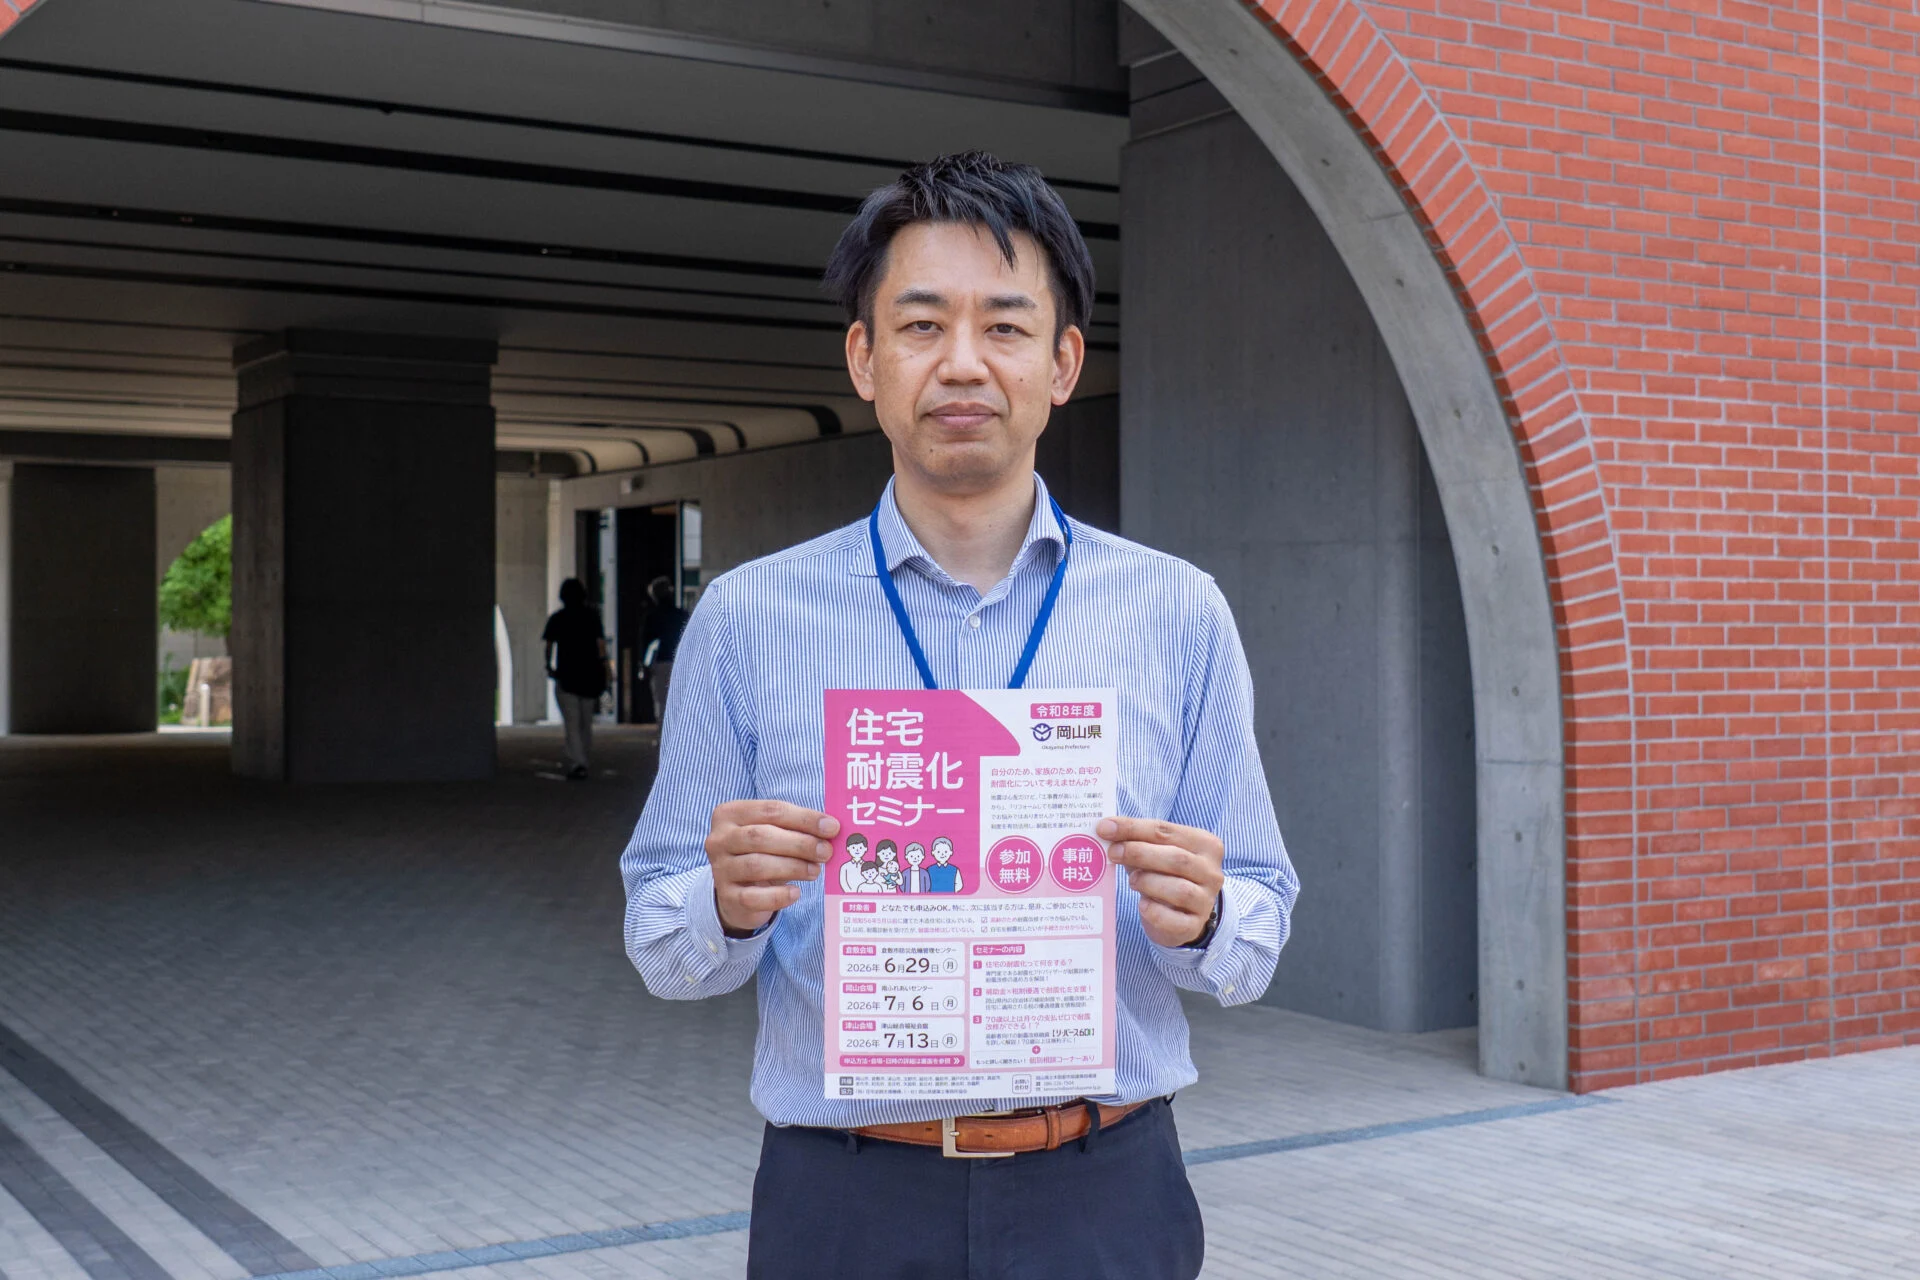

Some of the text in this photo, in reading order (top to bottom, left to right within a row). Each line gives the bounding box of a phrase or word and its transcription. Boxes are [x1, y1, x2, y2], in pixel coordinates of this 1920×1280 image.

[1036, 704, 1095, 717] 令和8年度
[846, 708, 924, 746] 住宅
[1056, 724, 1102, 740] 岡山県
[846, 752, 964, 790] 耐震化
[991, 766, 1102, 776] 自分のため、家族のため、自宅の
[991, 778, 1098, 788] 耐震化について考えませんか？
[846, 796, 965, 827] セミナー
[999, 849, 1030, 864] 参加
[1062, 848, 1093, 864] 事前
[999, 868, 1030, 884] 無料
[1062, 866, 1093, 882] 申込
[848, 903, 870, 912] 対象者
[976, 946, 1023, 954] セミナーの内容
[847, 963, 880, 973] 2026年
[884, 957, 939, 973] 6月29日
[986, 959, 1073, 968] 住宅の耐震化って何をする？
[847, 1001, 880, 1011] 2026年
[846, 1039, 880, 1048] 2026年
[884, 1033, 939, 1048] 7月13日
